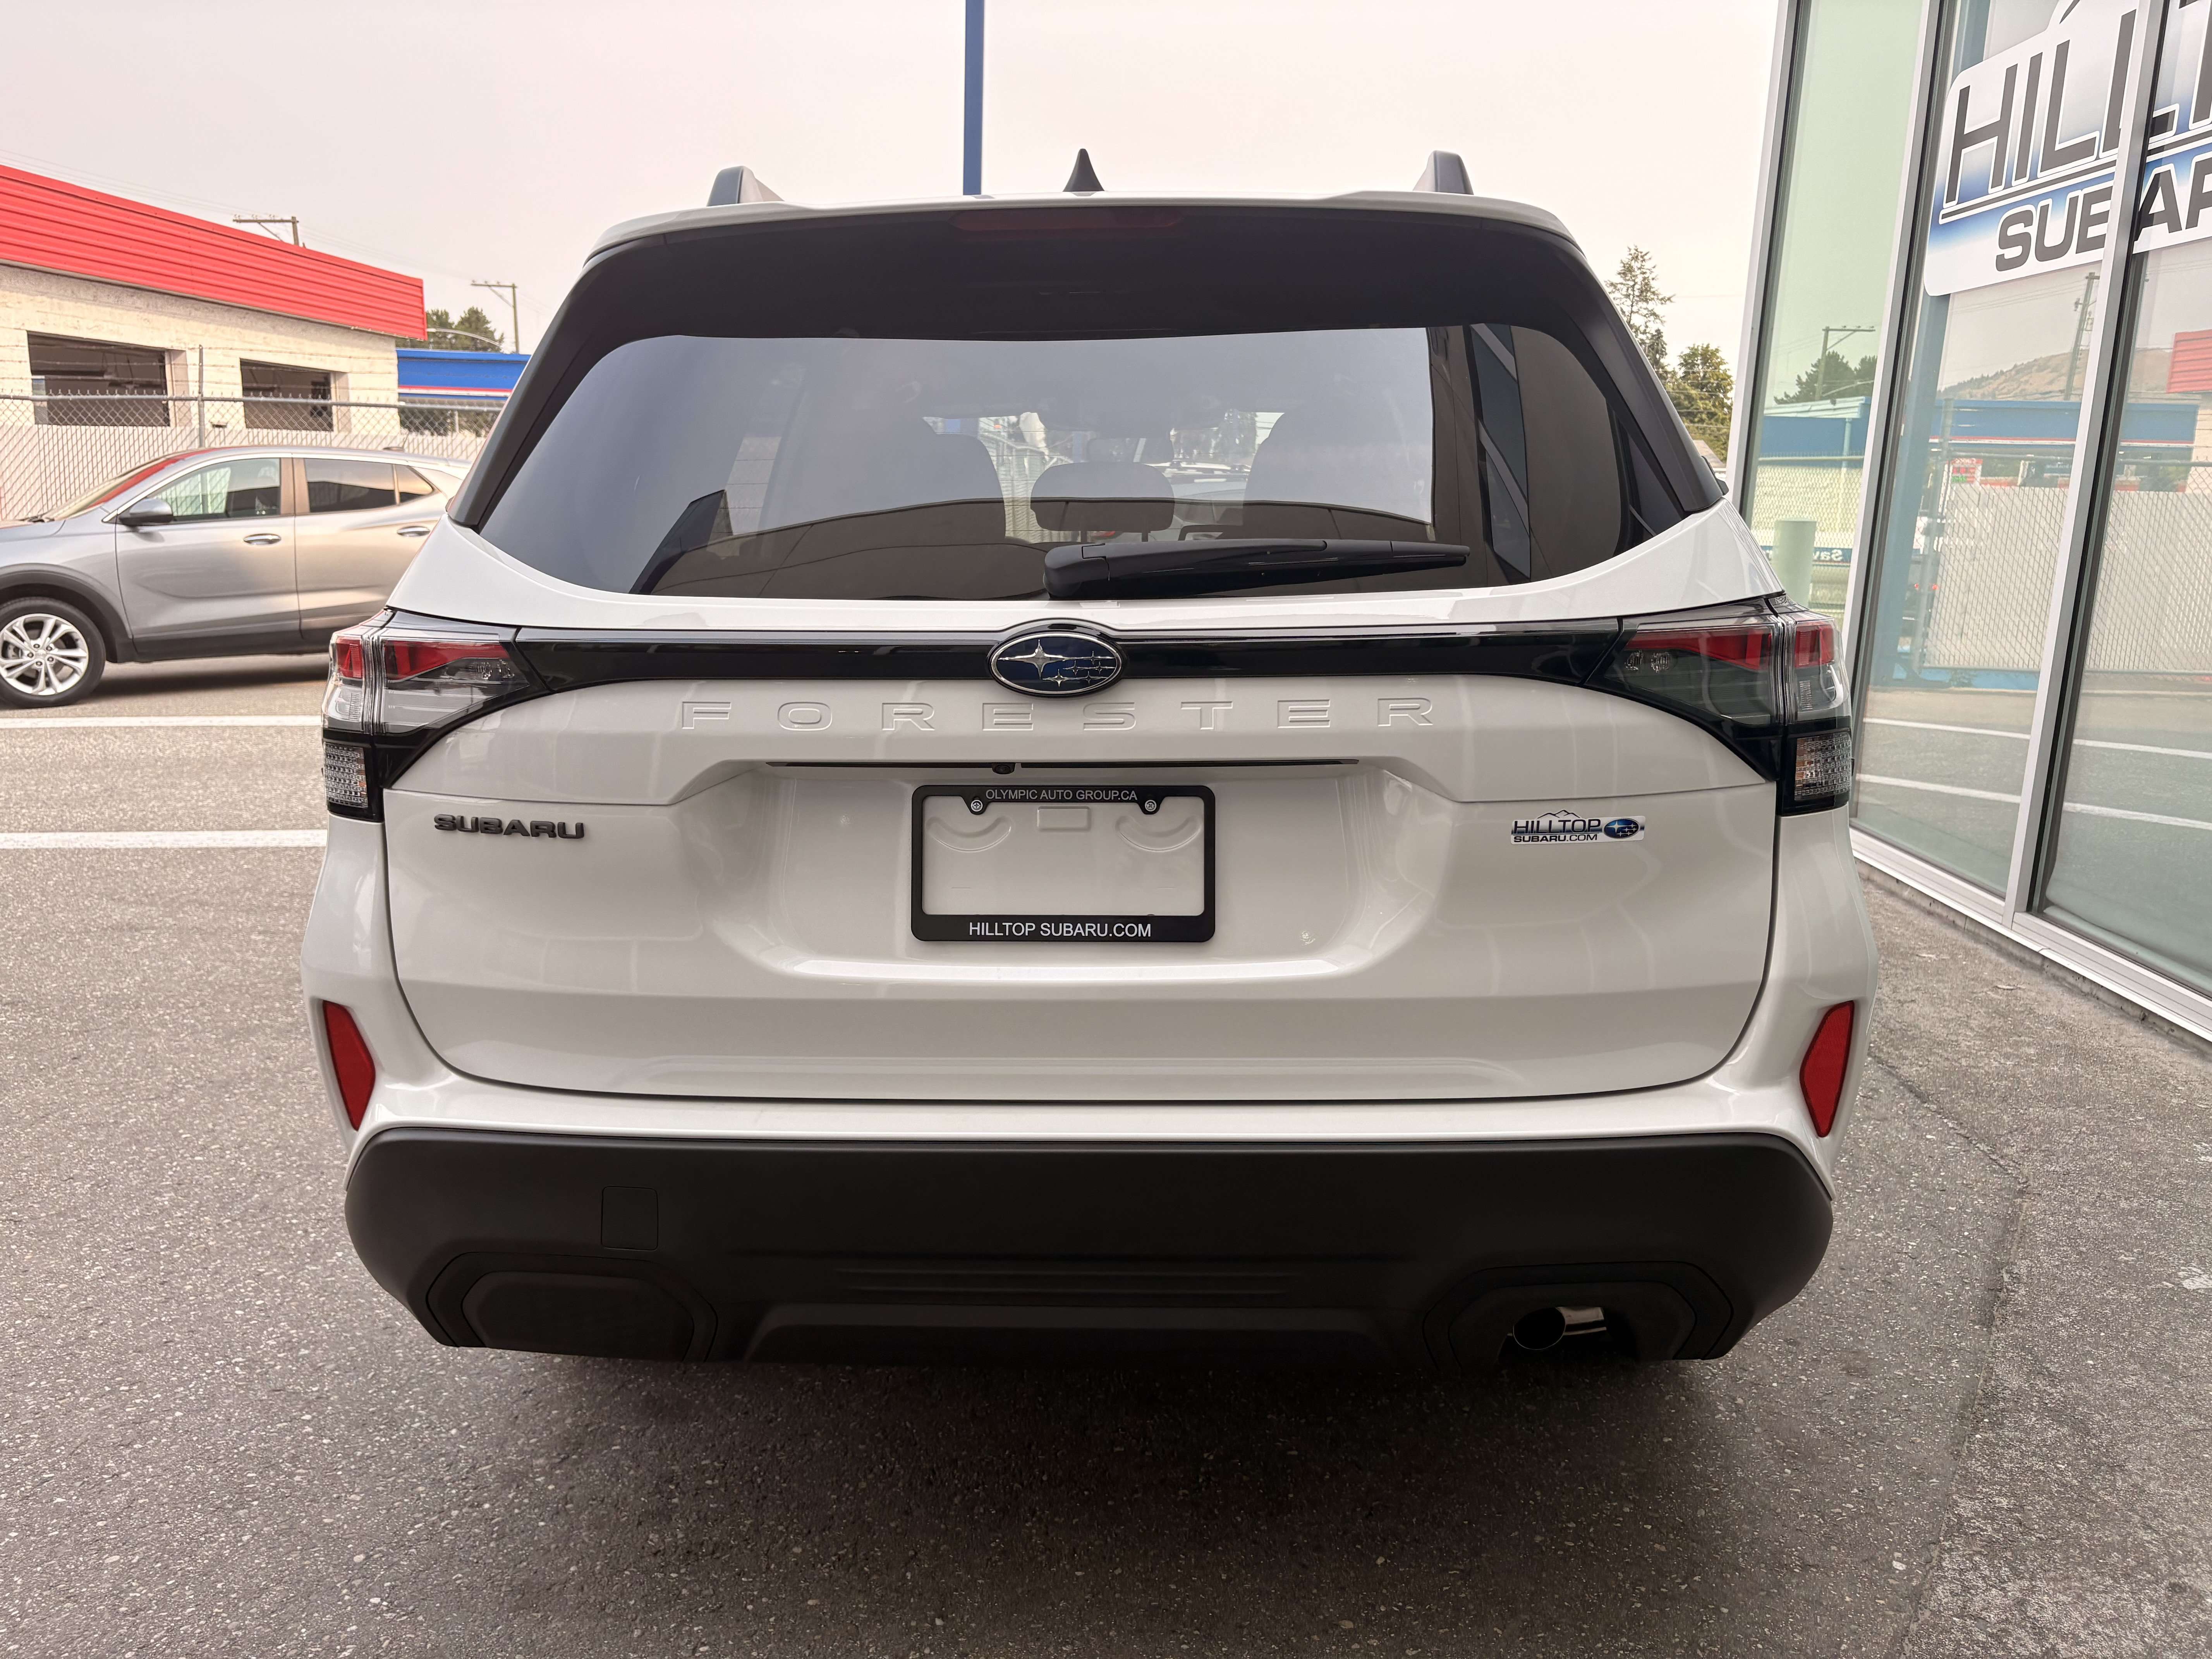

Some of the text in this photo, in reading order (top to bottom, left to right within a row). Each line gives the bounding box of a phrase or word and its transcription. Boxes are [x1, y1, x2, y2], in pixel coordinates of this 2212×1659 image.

[681, 697, 1434, 731] FORESTER
[986, 789, 1138, 800] OLYMPIC AUTO GROUP.CA
[434, 814, 584, 839] SUBARU
[1513, 819, 1601, 834] HILLTOP
[1513, 834, 1597, 842] SUBARU.COM
[969, 922, 1151, 937] HILLTOP SUBARU.COM
